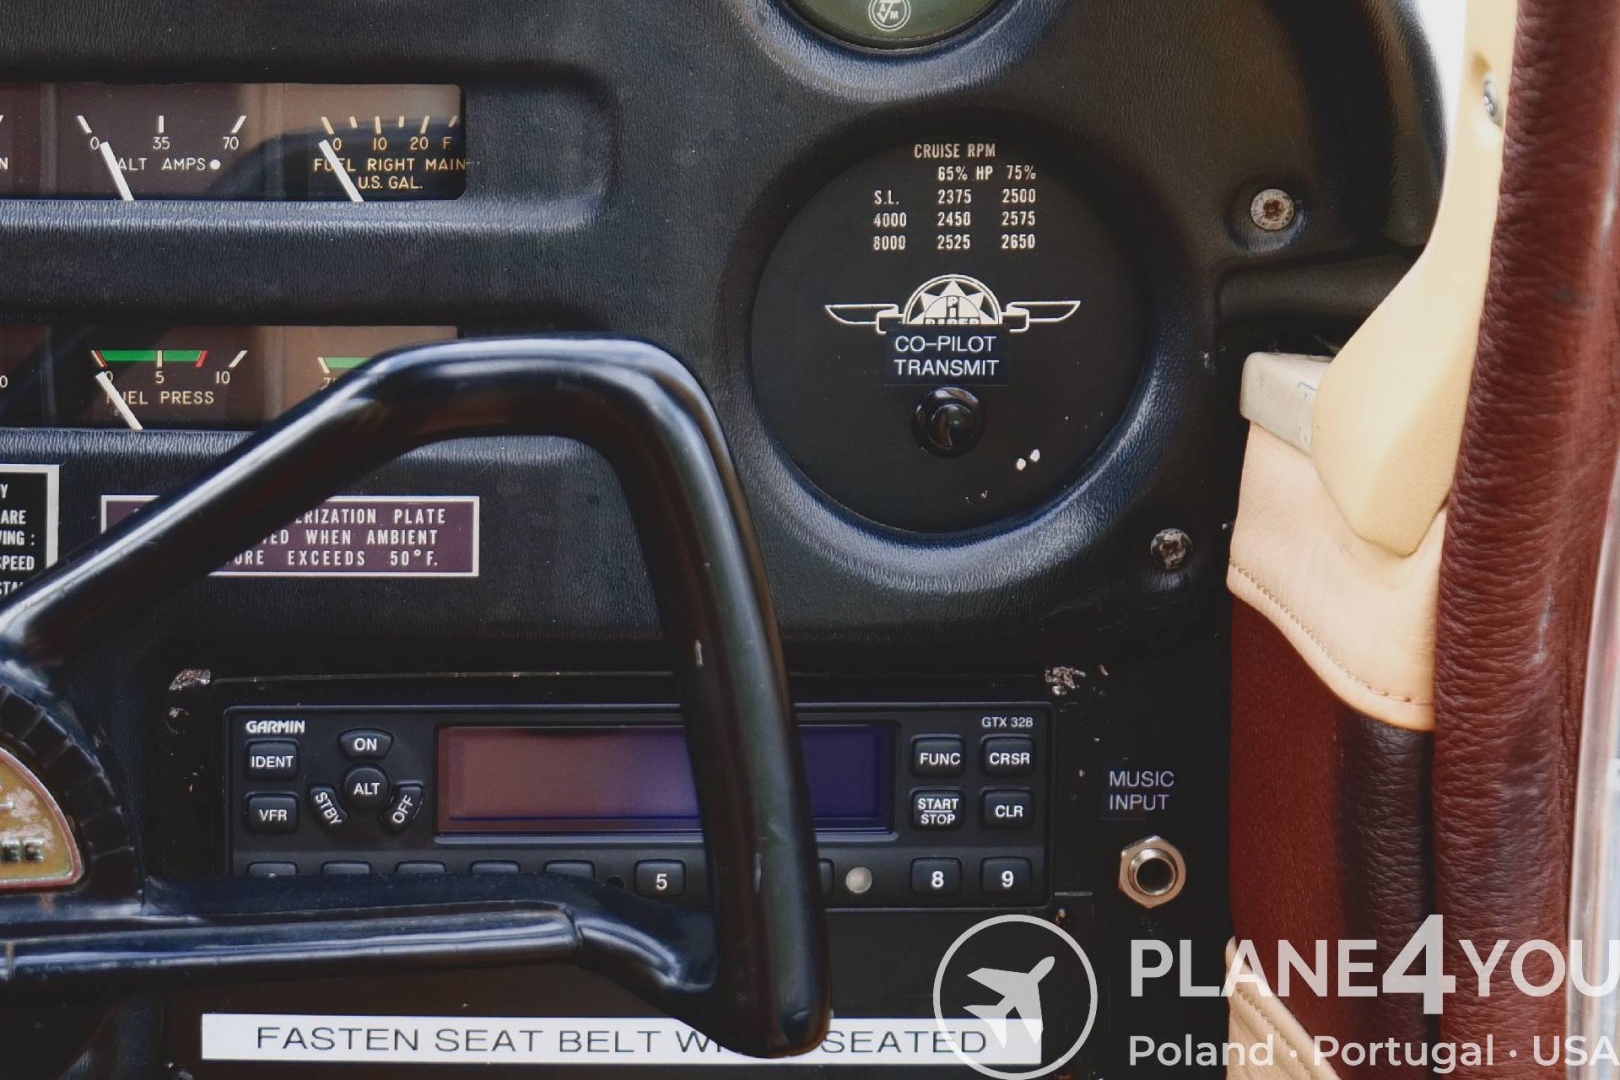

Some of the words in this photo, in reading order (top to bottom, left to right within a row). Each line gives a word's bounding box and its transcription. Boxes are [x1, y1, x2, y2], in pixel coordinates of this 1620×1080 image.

[914, 144, 961, 158] CRUISE
[967, 143, 996, 157] RPM
[368, 158, 415, 171] RIGHT
[425, 158, 466, 170] MAIN
[937, 166, 968, 181] 65%
[976, 166, 994, 180] HP
[1006, 165, 1037, 180] 75%
[874, 190, 900, 205] S.L.
[937, 189, 972, 204] 2375
[1002, 189, 1036, 203] 2500
[874, 213, 907, 228] 4000
[937, 212, 972, 226] 2450
[1001, 212, 1036, 226] 2575
[873, 235, 907, 251] 8000
[937, 235, 971, 249] 2525
[1001, 234, 1036, 249] 2650
[895, 335, 996, 352] CO-PILOT
[894, 359, 1000, 376] TRANSMIT
[160, 391, 214, 405] PRESS
[0, 510, 27, 525] ARE
[394, 509, 446, 525] PLATE
[306, 530, 352, 544] WHEN
[367, 529, 438, 545] AMBIENT
[287, 550, 366, 566] EXCEEDS
[245, 720, 305, 735] GARMIN
[354, 737, 378, 752] ON
[250, 755, 293, 769] IDENT
[919, 752, 961, 766] FUNC
[989, 752, 1031, 766] CRSR
[1109, 770, 1175, 788] MUSIC
[353, 782, 380, 796] ALT
[917, 798, 959, 811] START
[1109, 795, 1170, 811] INPUT
[259, 809, 288, 822] VFR
[920, 813, 957, 826] STOP
[994, 805, 1024, 819] CLR
[257, 1027, 420, 1052] FASTEN
[434, 1029, 543, 1053] SEAT
[558, 1030, 661, 1054] BELT
[821, 1030, 988, 1054] SEATED
